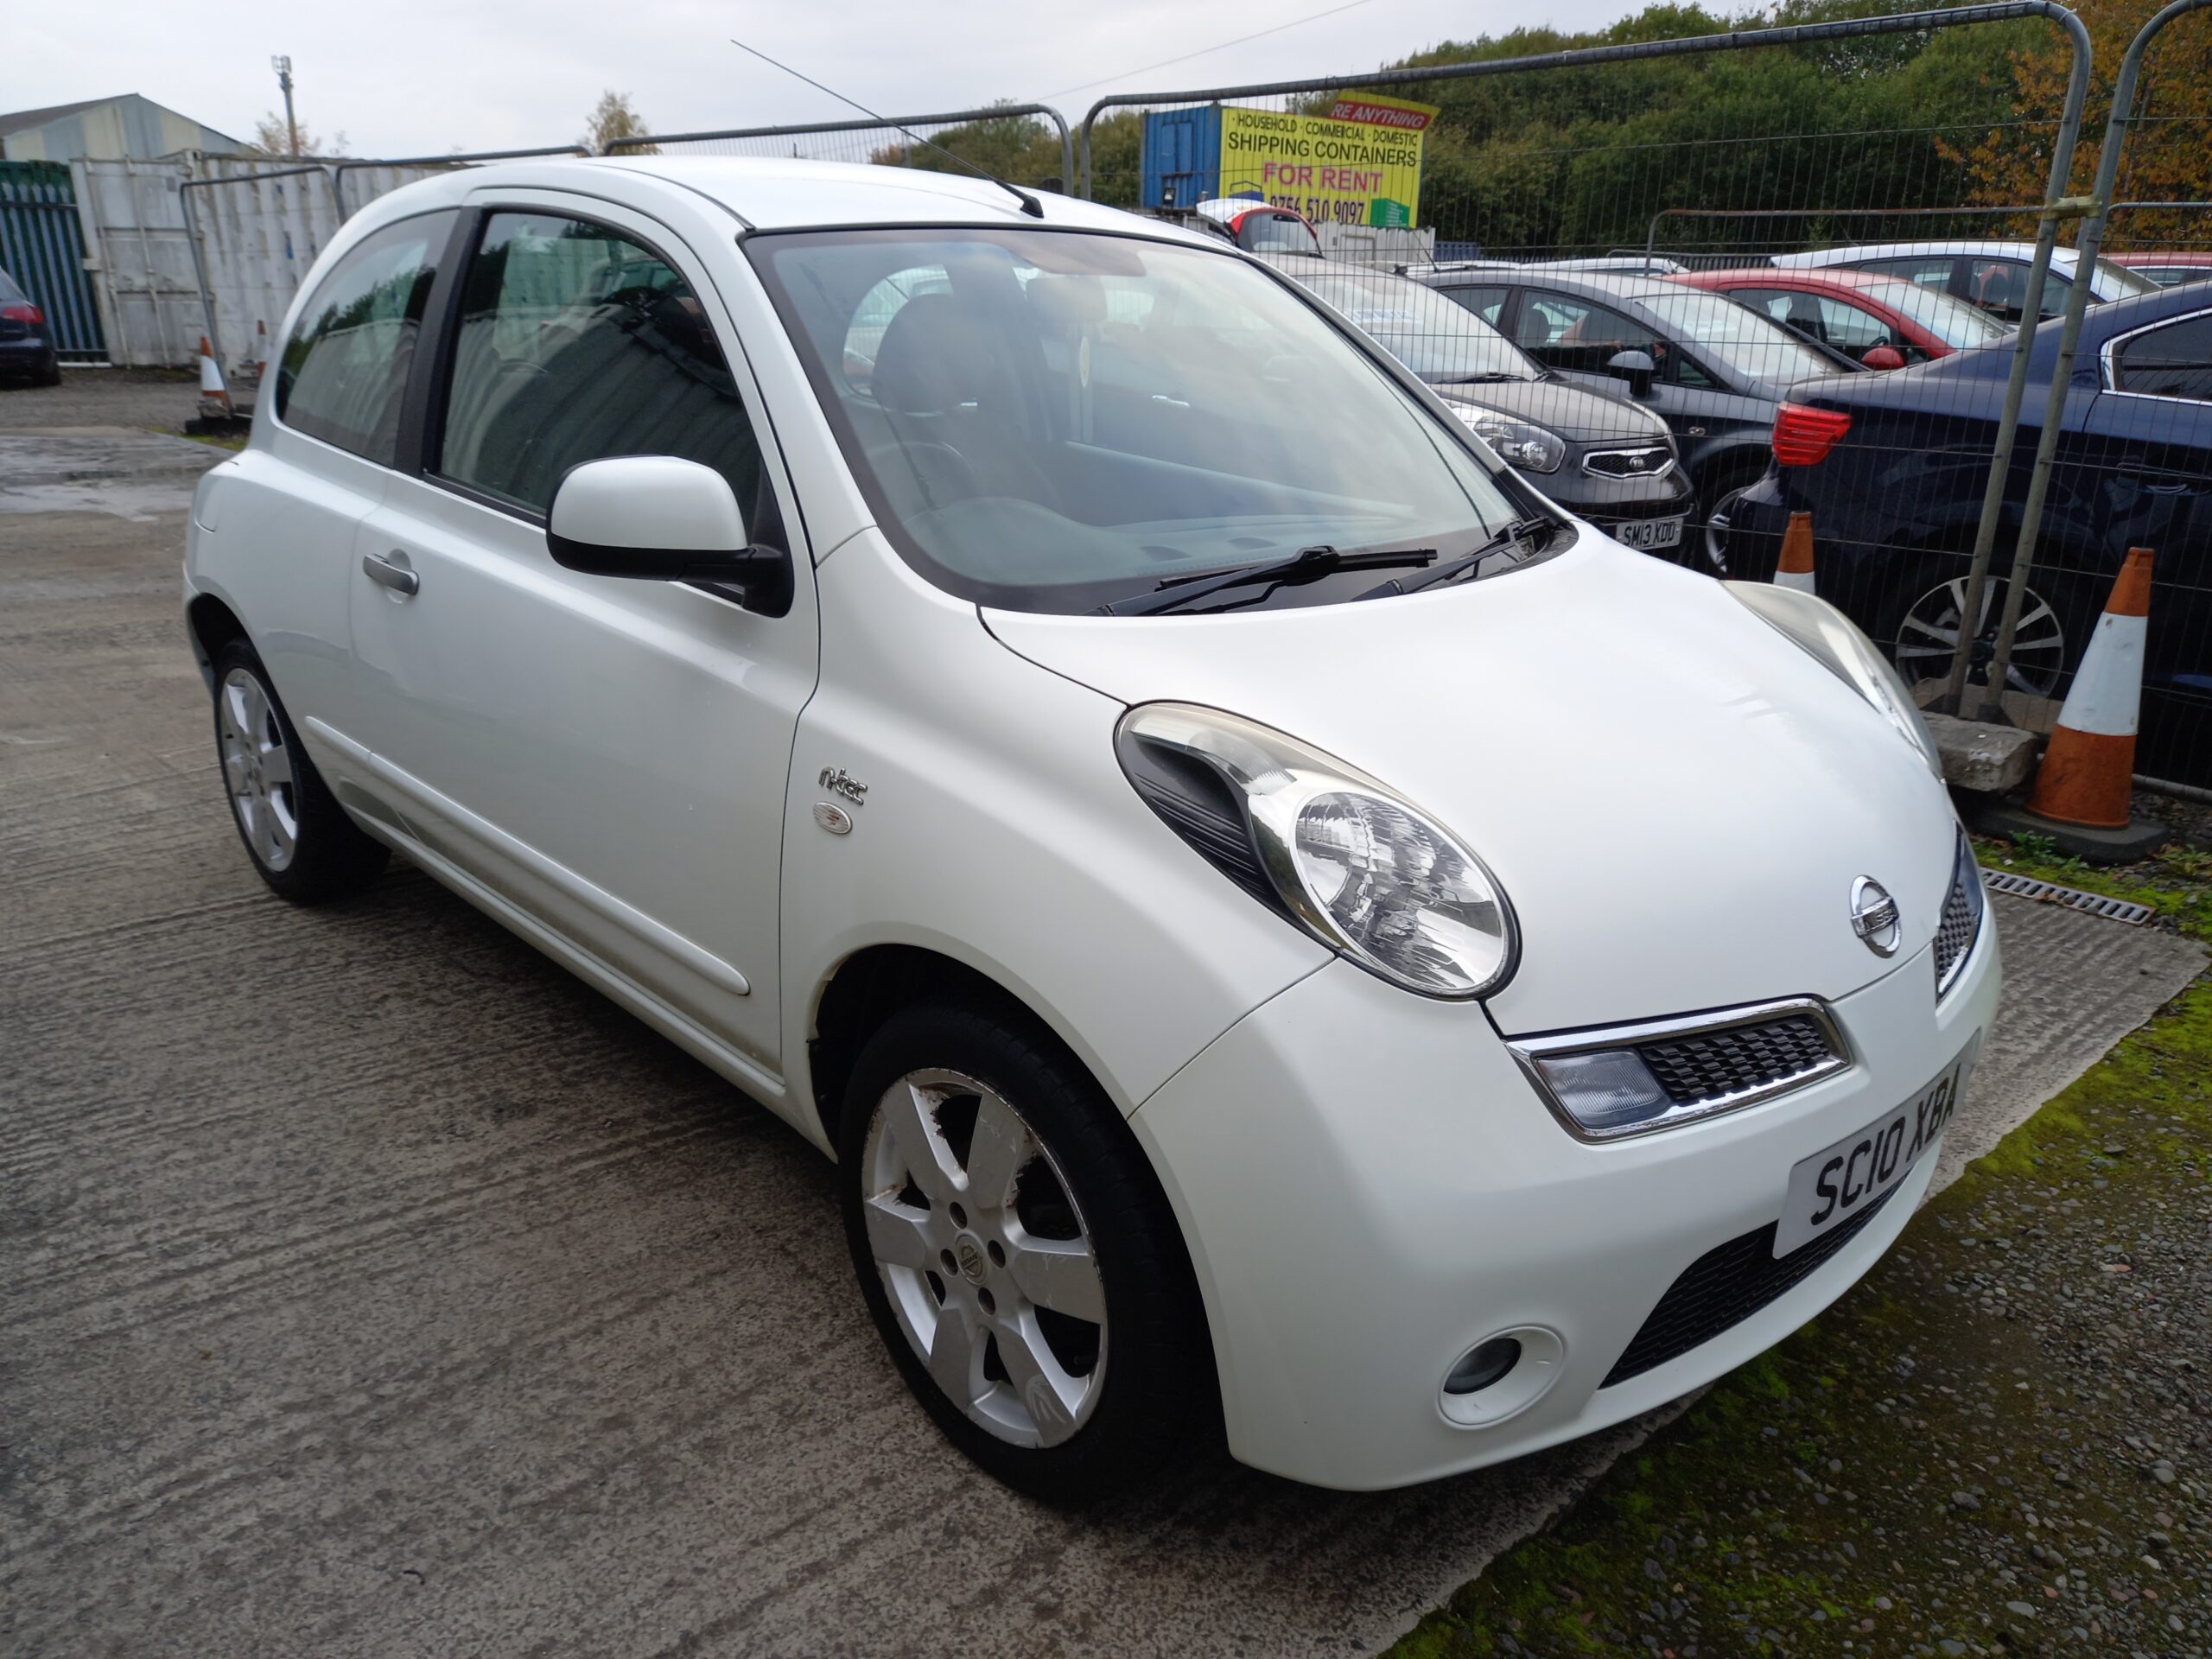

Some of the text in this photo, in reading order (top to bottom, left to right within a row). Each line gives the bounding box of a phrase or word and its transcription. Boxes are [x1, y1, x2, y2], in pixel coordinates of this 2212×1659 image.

[1238, 113, 1417, 146] HOUSEHOLD COMMERCIAL DOMESTIC
[1351, 106, 1425, 128] ANYTHING
[1228, 132, 1417, 167] SHIPPING CONTAINERS
[1263, 162, 1383, 194] FOR RENT
